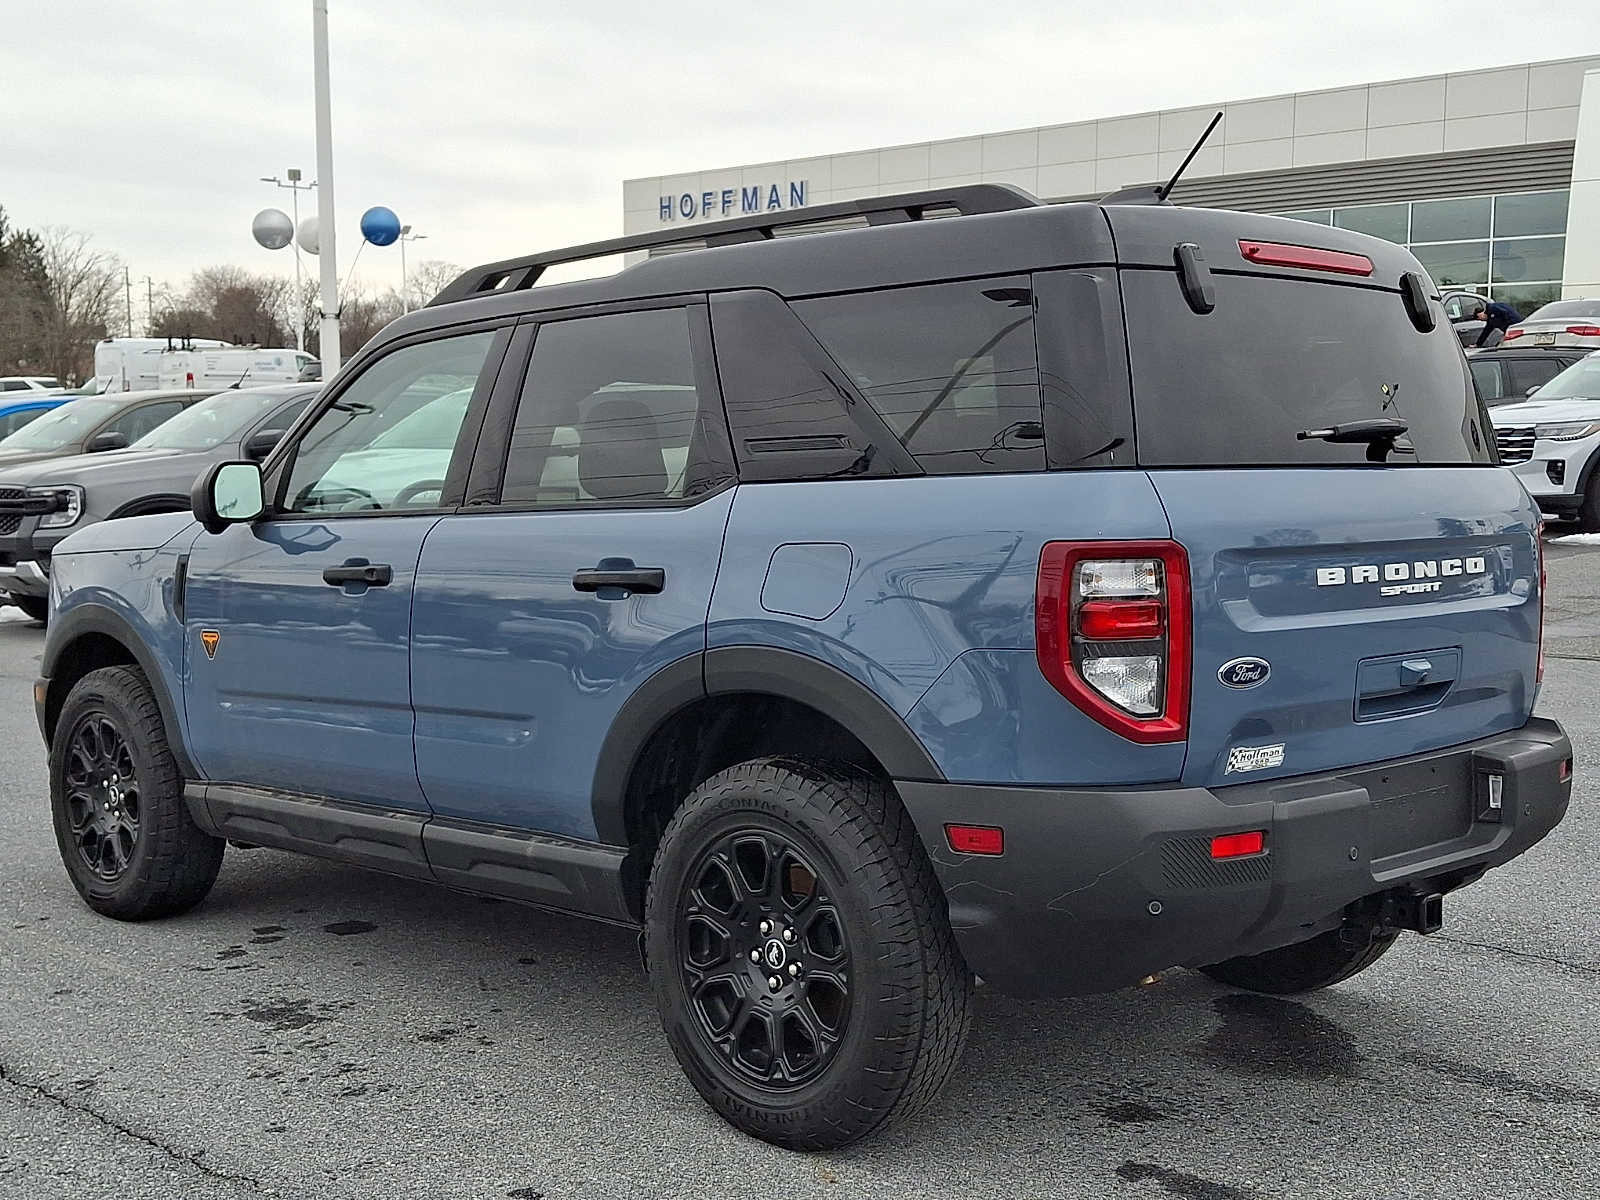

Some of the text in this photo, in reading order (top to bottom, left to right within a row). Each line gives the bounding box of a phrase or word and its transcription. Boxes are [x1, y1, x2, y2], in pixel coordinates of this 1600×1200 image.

[660, 181, 805, 220] HOFFMAN
[1317, 557, 1485, 586] BRONCO
[1380, 581, 1443, 596] SPORT
[1233, 663, 1262, 682] Ford
